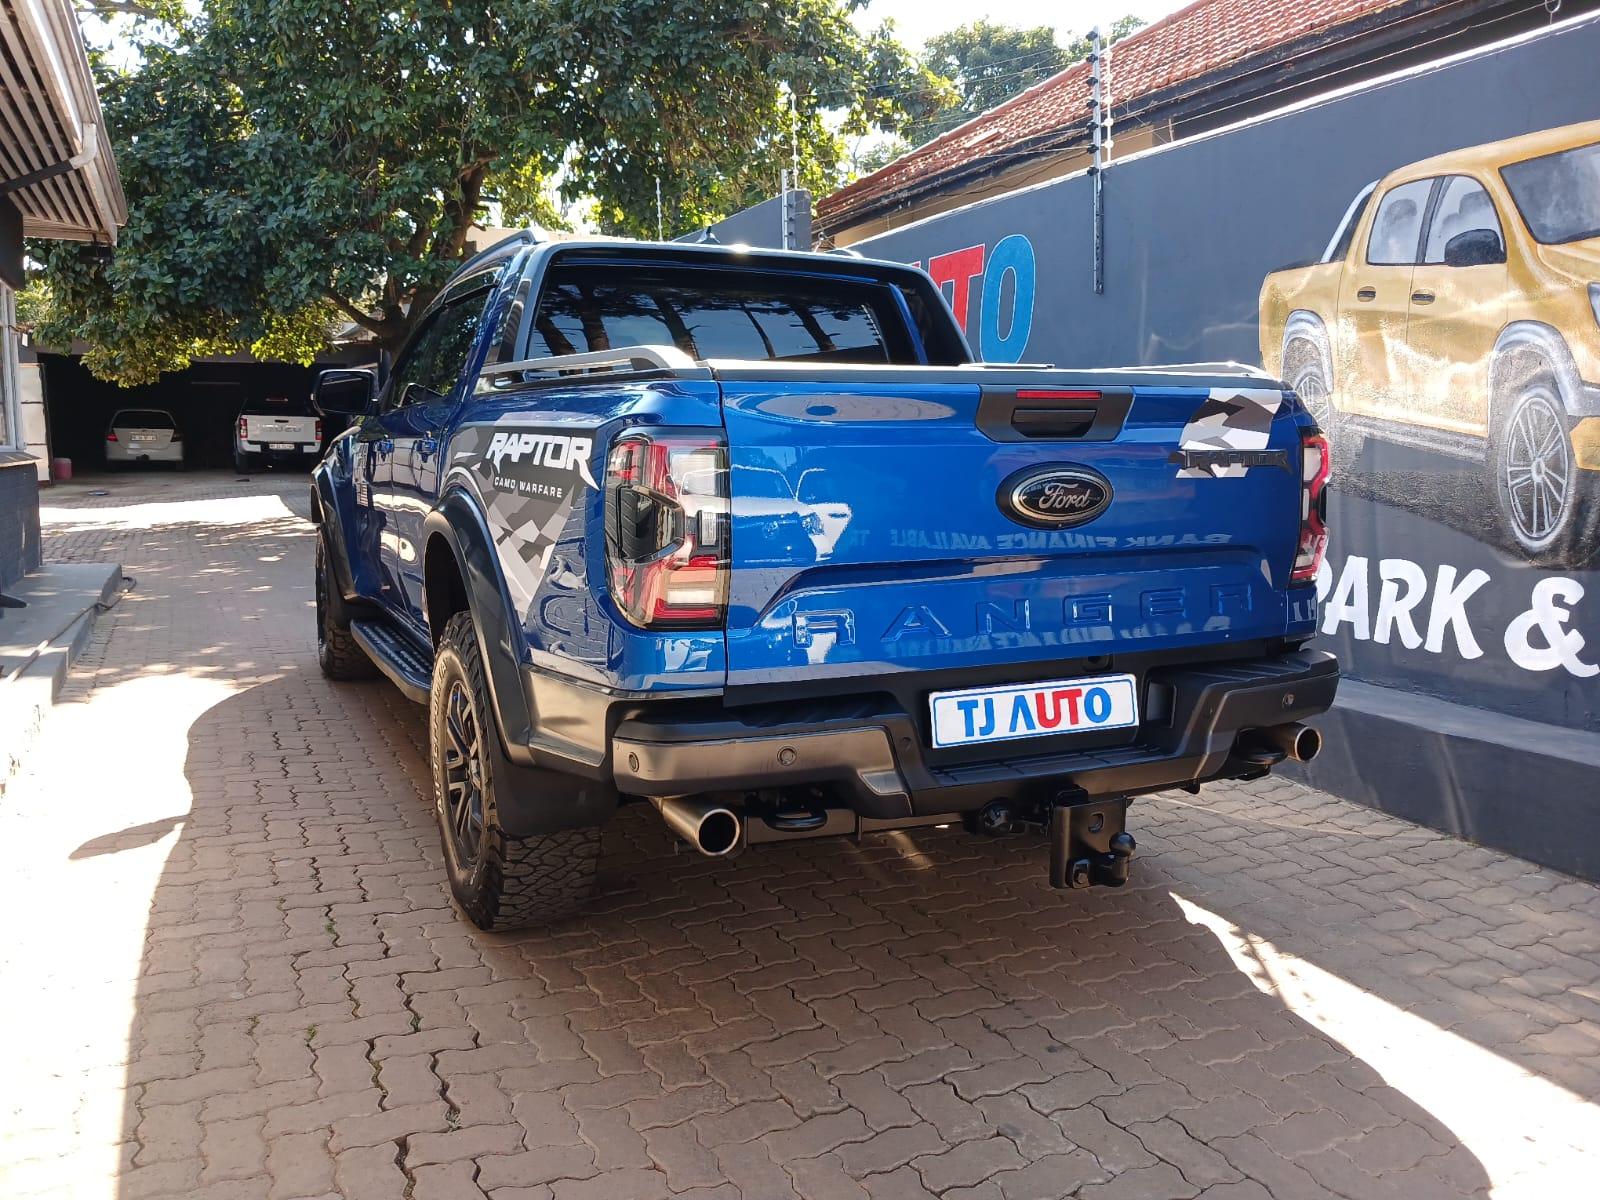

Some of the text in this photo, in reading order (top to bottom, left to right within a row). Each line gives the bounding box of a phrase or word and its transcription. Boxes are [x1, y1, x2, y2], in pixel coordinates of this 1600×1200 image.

[911, 234, 1036, 364] TO
[486, 432, 600, 491] RAPTOR
[494, 476, 563, 498] CAMO WARFARE
[1039, 483, 1090, 509] Ford
[792, 582, 1253, 648] RANGER
[1504, 577, 1600, 678] &
[957, 687, 1112, 737] TJ AUTO
